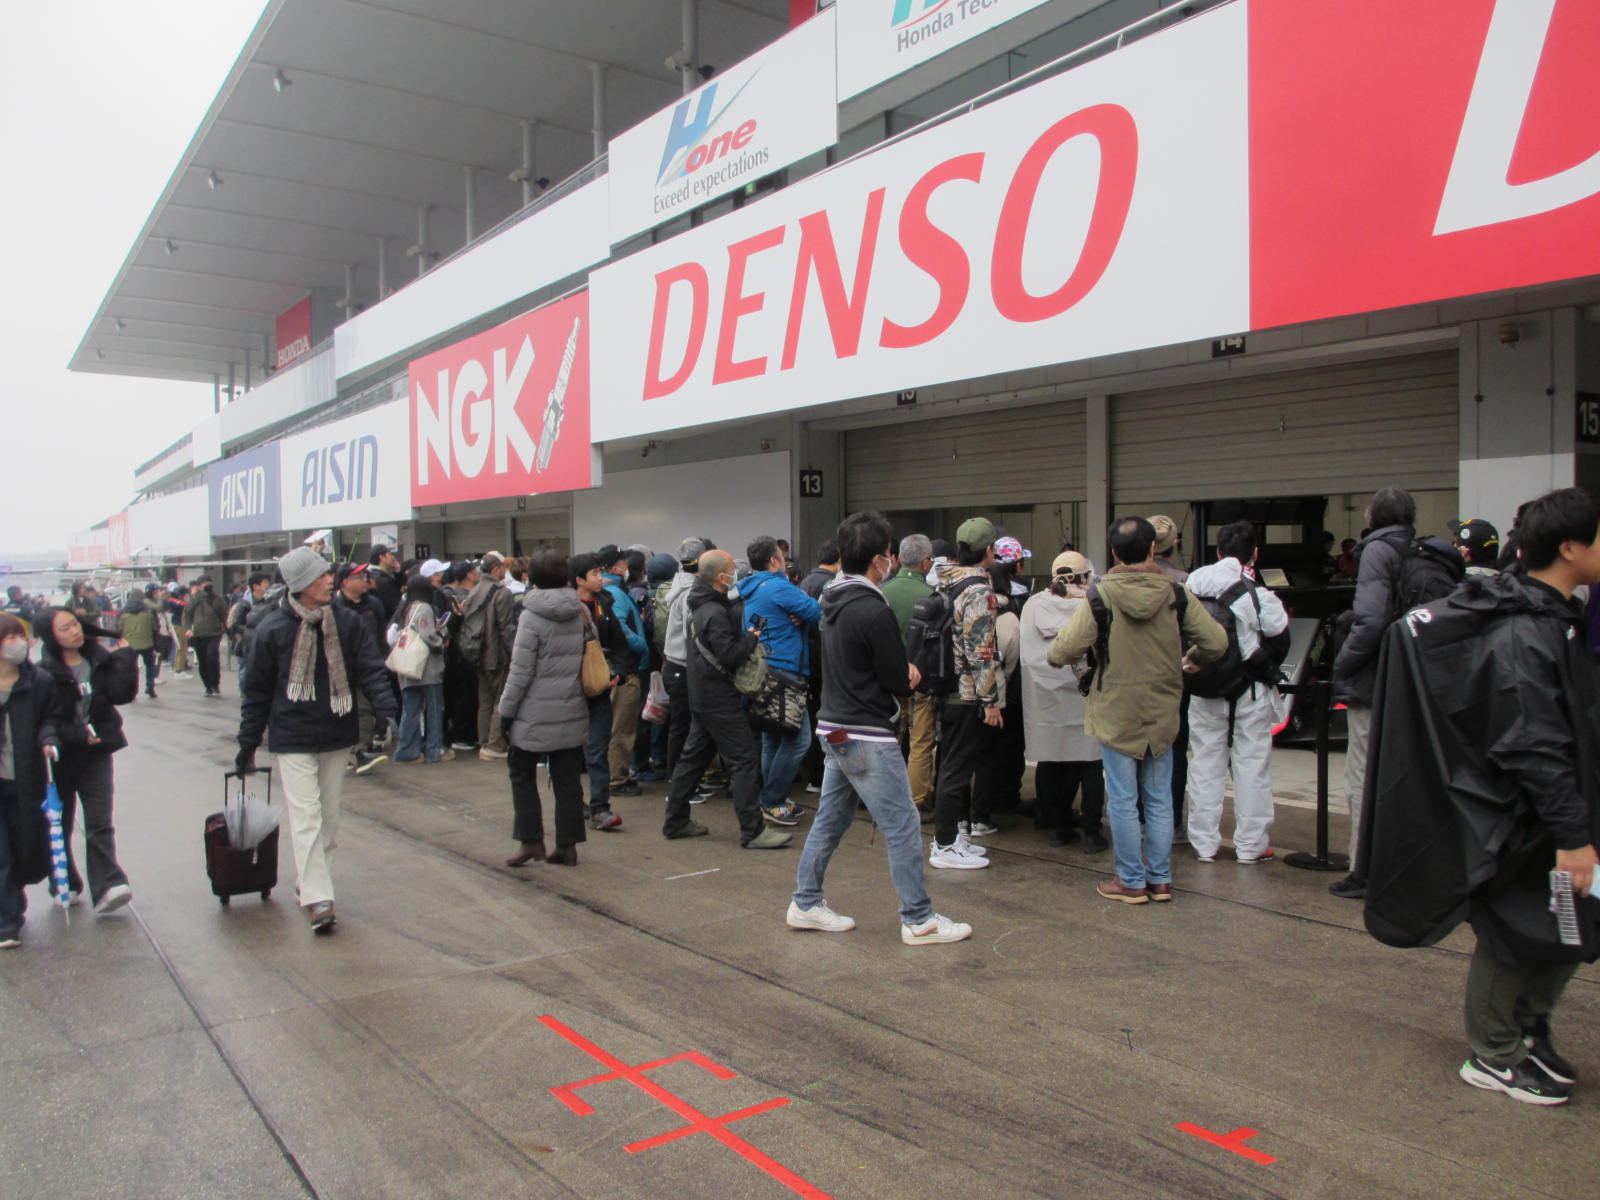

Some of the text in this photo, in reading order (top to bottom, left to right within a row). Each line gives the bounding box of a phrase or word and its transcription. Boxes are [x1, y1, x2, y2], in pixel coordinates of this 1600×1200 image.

[897, 11, 954, 52] Honda
[957, 0, 999, 20] Tec
[653, 146, 770, 214] Exceed expectations
[642, 102, 1138, 401] DENSO
[277, 335, 310, 368] HONDA
[416, 333, 537, 486] NGK
[1579, 401, 1600, 436] 15
[220, 465, 266, 520] AISIN
[301, 434, 379, 507] AISIN
[802, 474, 822, 494] 13
[416, 546, 429, 558] 11
